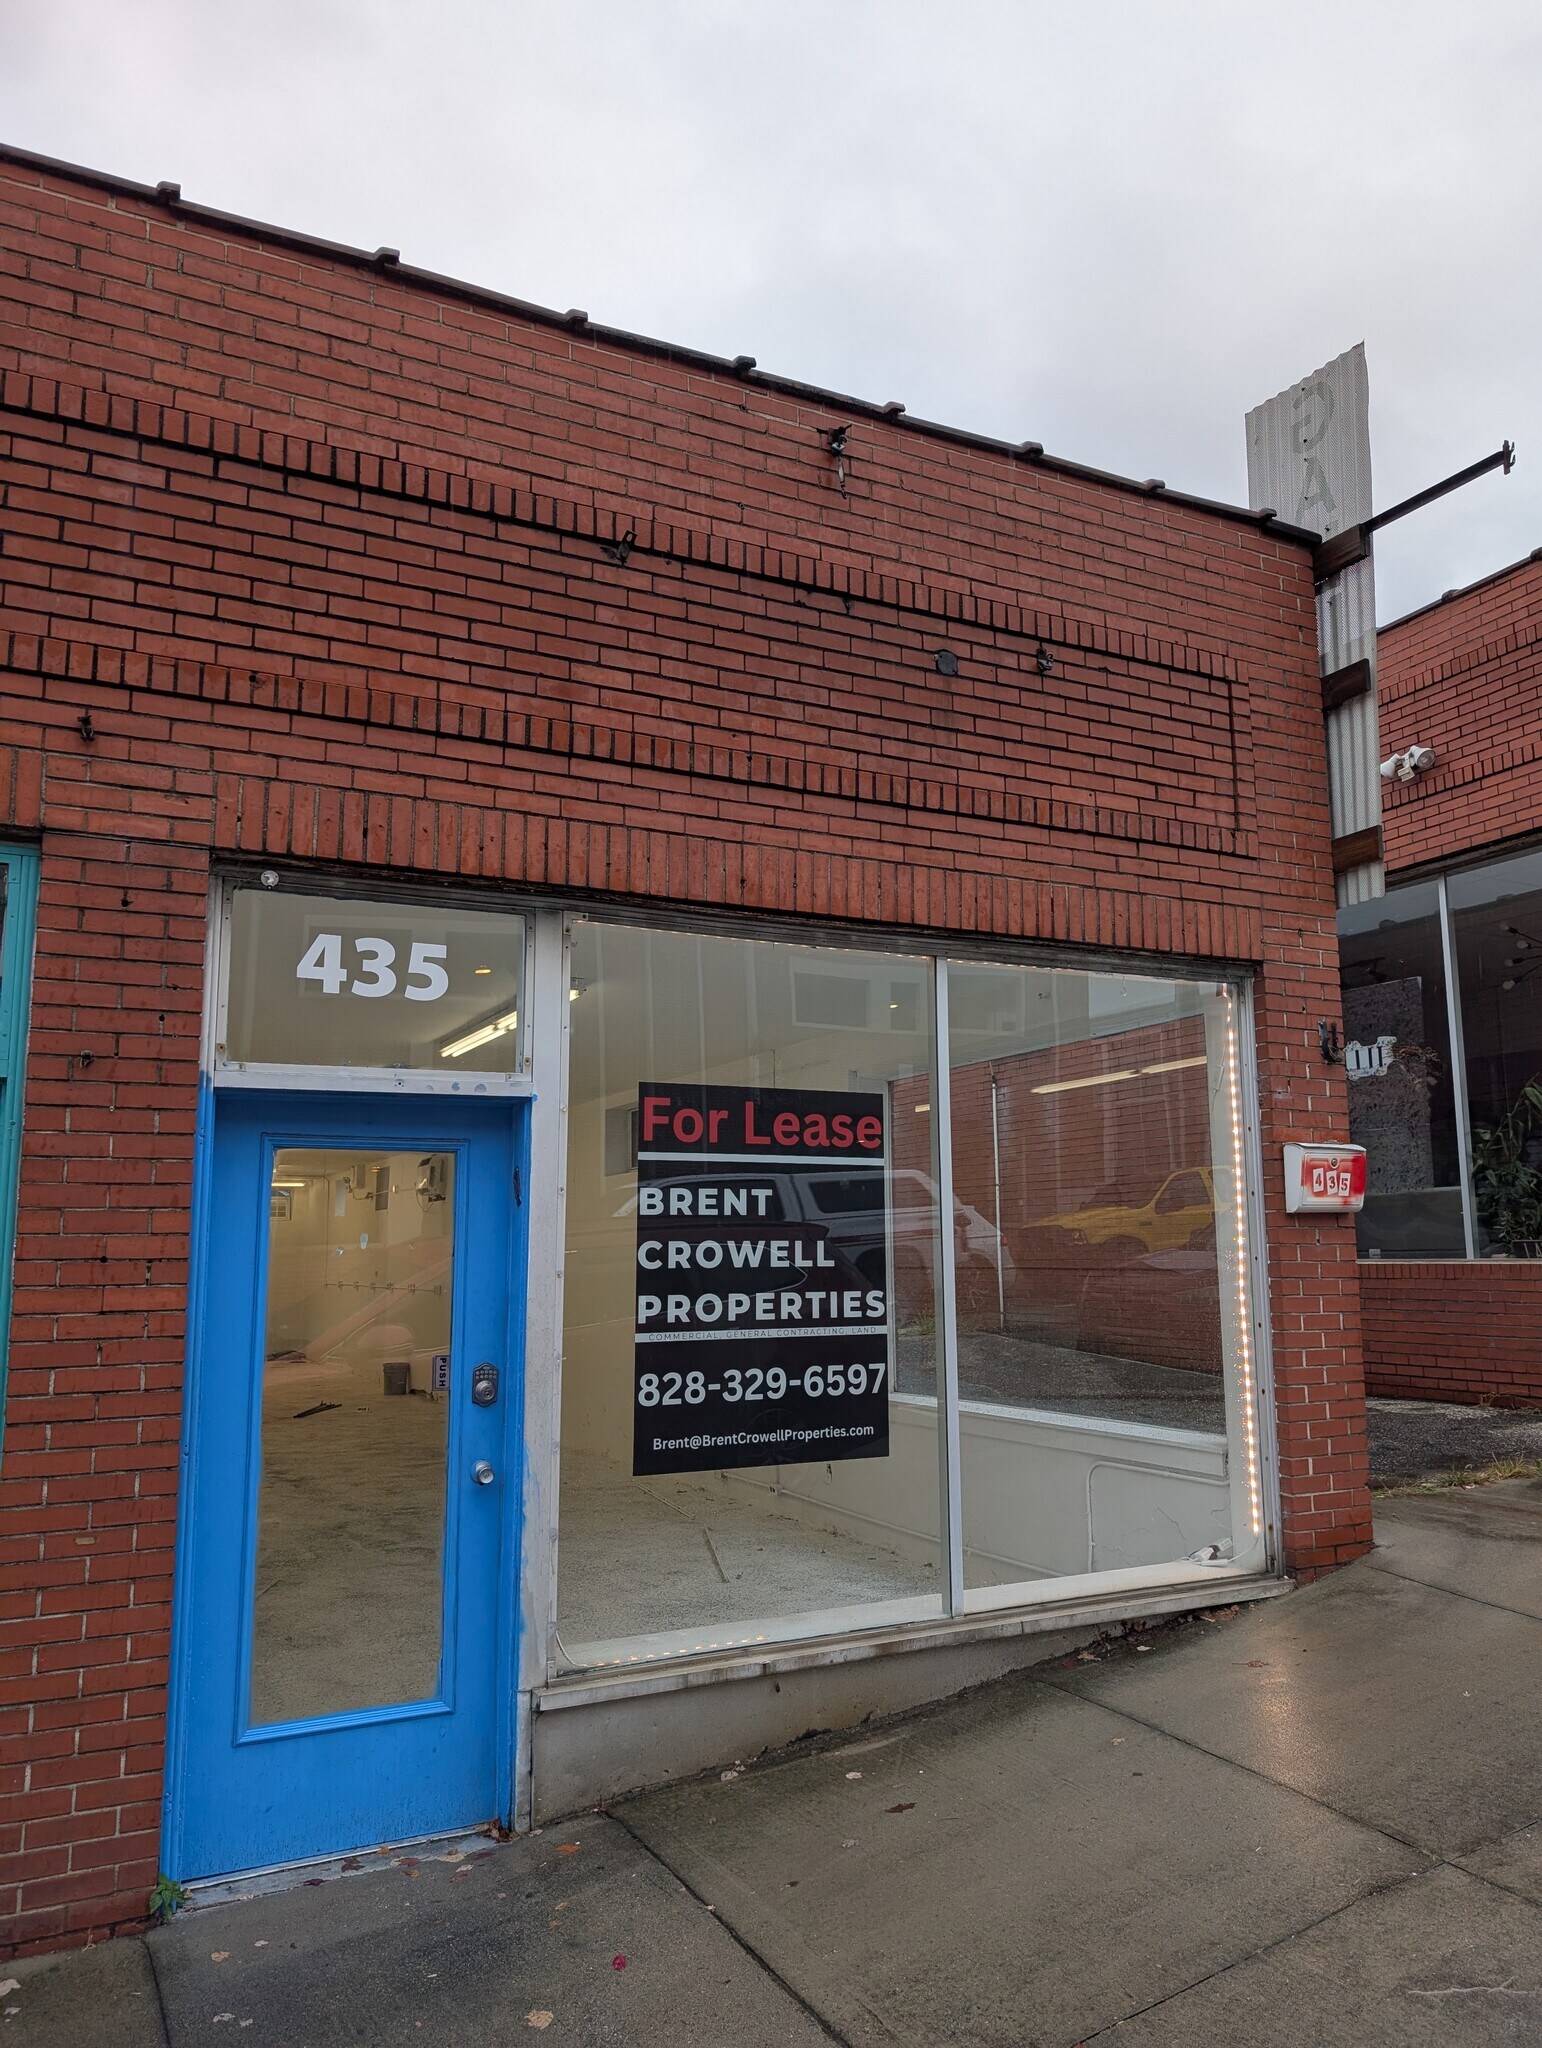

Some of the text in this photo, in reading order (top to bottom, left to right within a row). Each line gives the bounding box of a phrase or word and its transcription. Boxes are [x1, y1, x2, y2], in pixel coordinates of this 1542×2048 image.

[296, 933, 449, 1001] 435
[643, 1097, 882, 1149] For Lease
[1315, 1172, 1350, 1193] 435
[639, 1187, 773, 1216] BRENT
[637, 1240, 835, 1269] CROWELL
[637, 1290, 886, 1325] PROPERTIES
[648, 1325, 877, 1342] COMMERCIAL, GENERAL CONTRACTING, LAND
[439, 1357, 447, 1387] PUSH
[638, 1363, 886, 1407] 828-329-6597
[653, 1425, 875, 1450] Brent@BrentCrowellProperties.com
